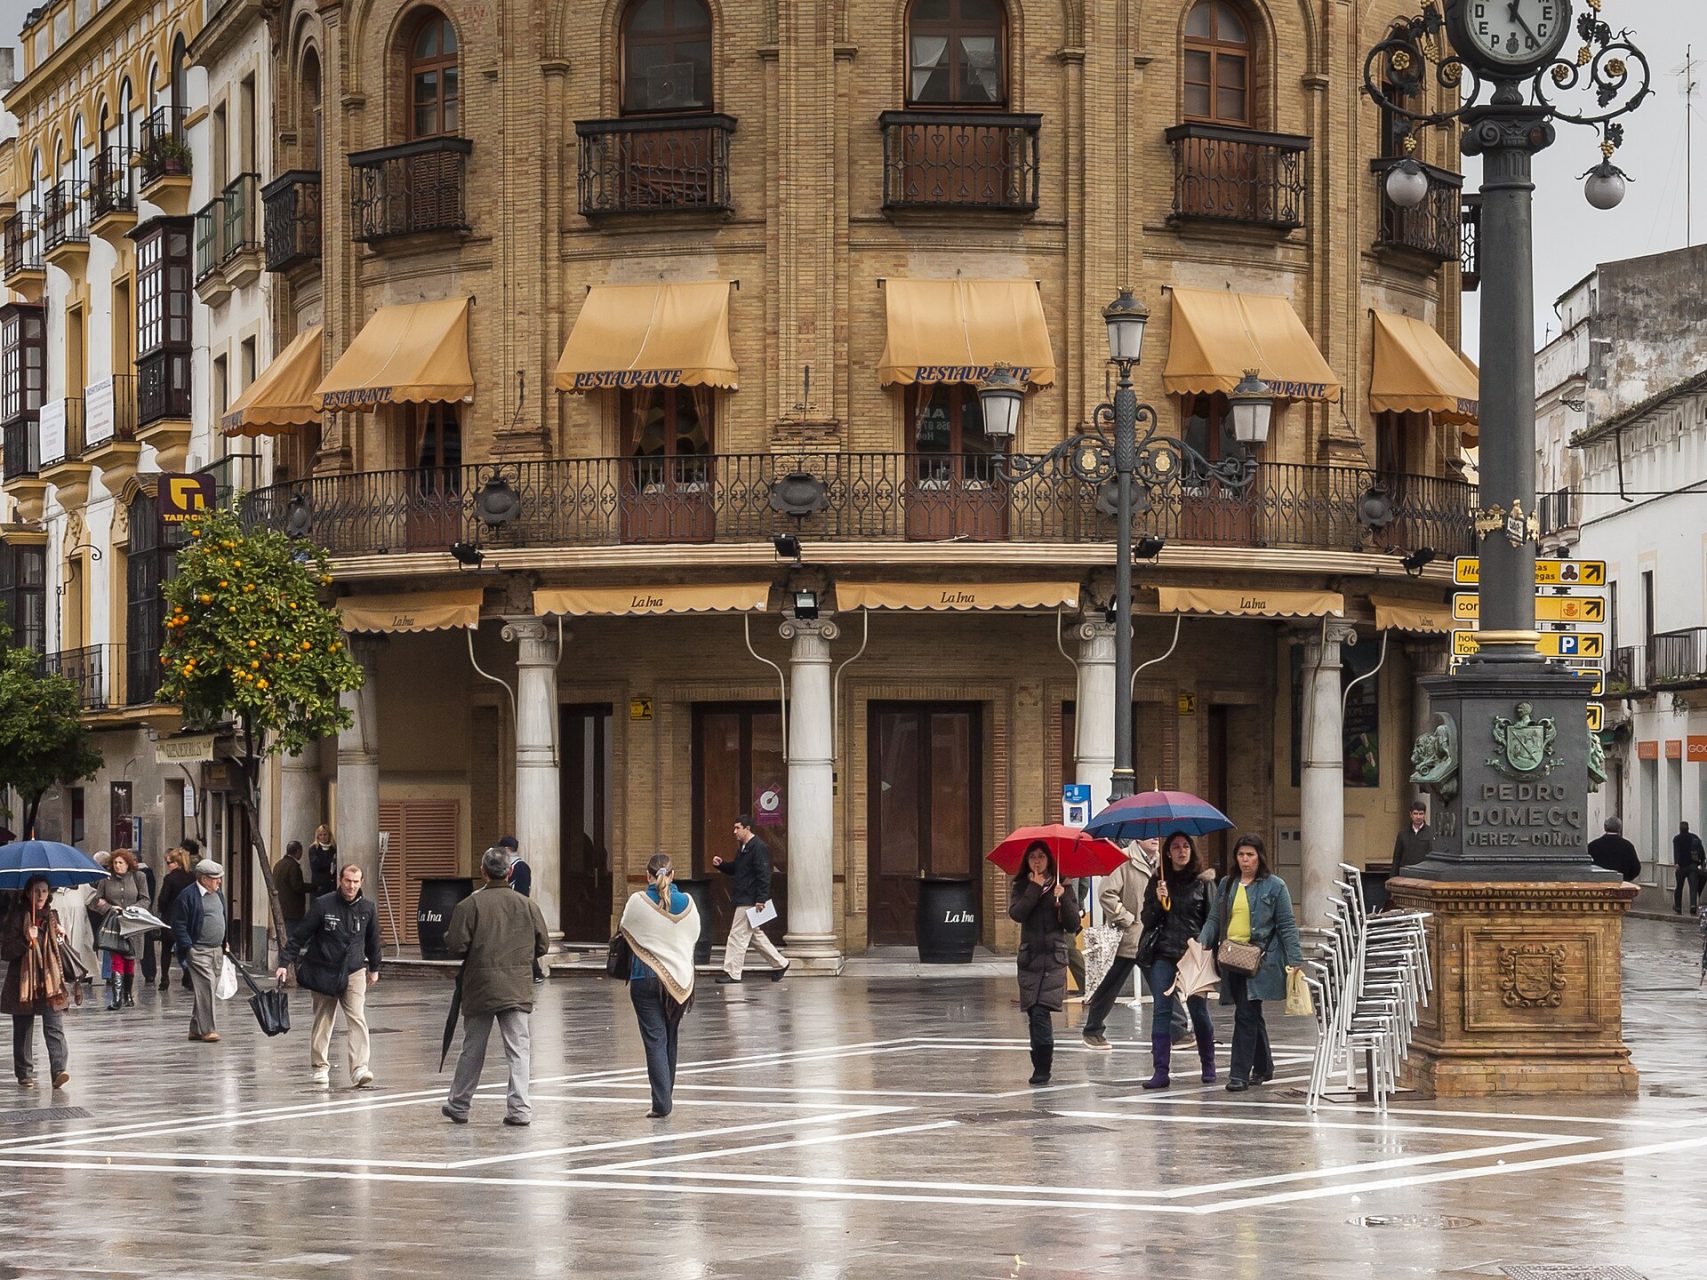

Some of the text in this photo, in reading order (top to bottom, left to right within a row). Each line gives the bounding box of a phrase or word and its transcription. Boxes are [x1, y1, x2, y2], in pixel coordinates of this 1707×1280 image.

[574, 369, 683, 387] RESTAURANTE
[915, 366, 1032, 381] RESTAURTE
[322, 387, 393, 407] RESTAURANTE
[631, 596, 663, 608] La Ina
[940, 591, 975, 604] La Ina
[1240, 597, 1266, 609] La Ina
[1482, 783, 1567, 801] PEDRO
[1467, 806, 1582, 829] DOMECQ
[417, 909, 442, 922] La Ina
[944, 910, 975, 923] La Ina
